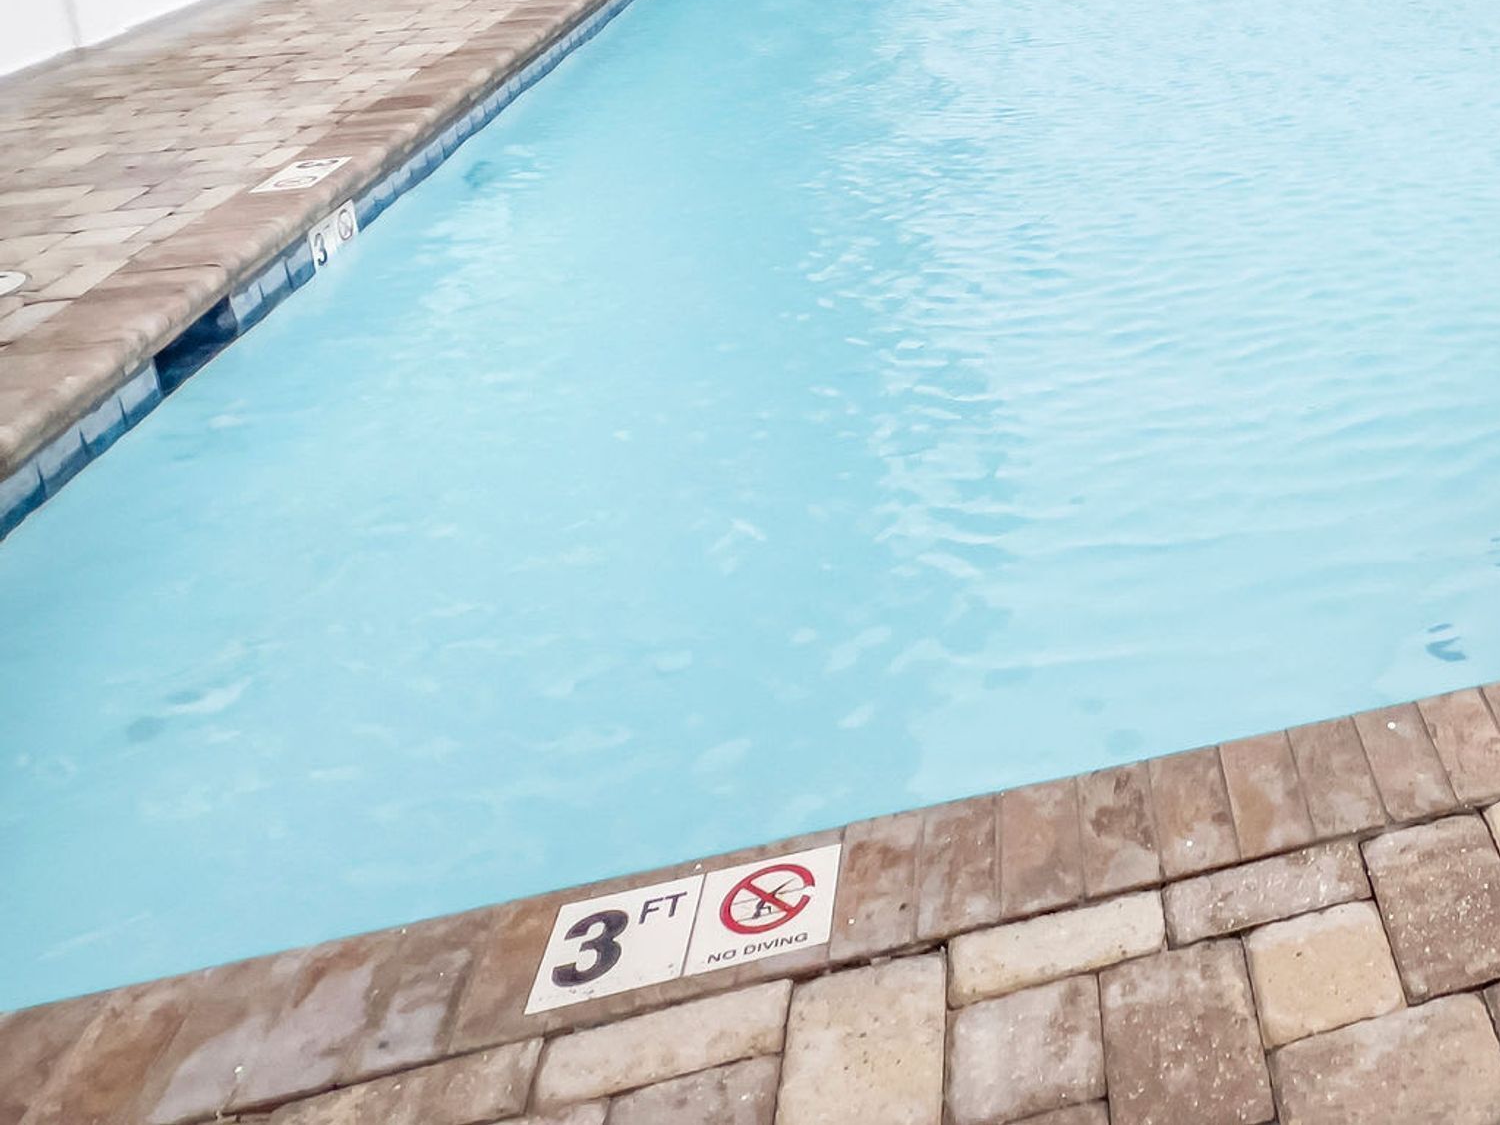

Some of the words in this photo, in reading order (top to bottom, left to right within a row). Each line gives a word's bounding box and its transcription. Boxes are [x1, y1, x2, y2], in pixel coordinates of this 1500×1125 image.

[314, 232, 328, 266] 3
[552, 909, 630, 988] 3
[638, 891, 689, 925] FT
[706, 947, 738, 965] NO
[744, 931, 809, 956] DIVING
